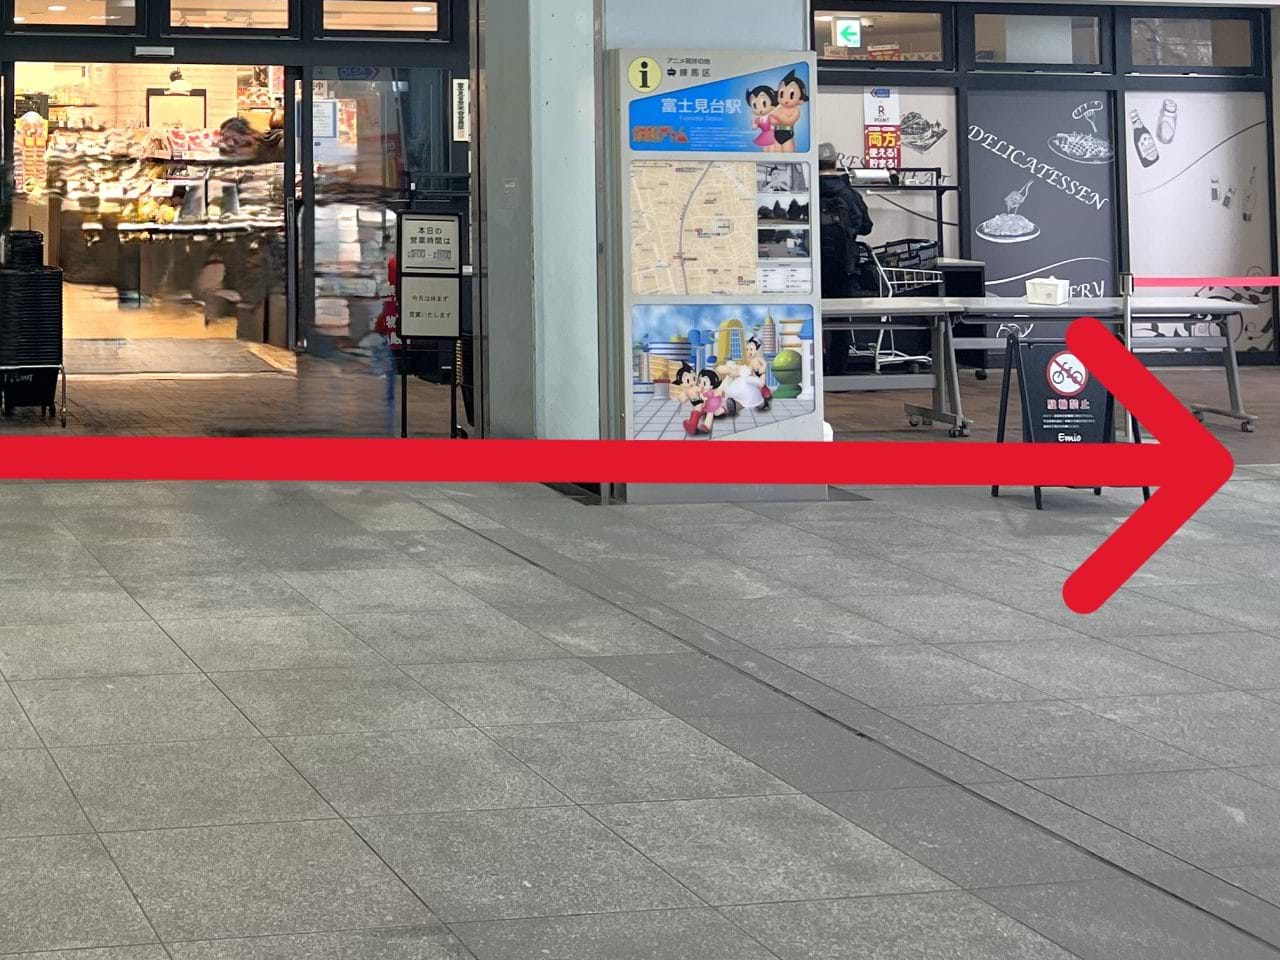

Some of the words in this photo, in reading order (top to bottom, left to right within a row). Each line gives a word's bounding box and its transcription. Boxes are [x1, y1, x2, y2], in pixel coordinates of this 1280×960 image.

[661, 98, 742, 114] 富士見台駅
[878, 105, 885, 115] R
[868, 131, 897, 147] 両方
[968, 125, 1109, 210] DELICATESSEN
[418, 226, 442, 235] 本日の
[410, 236, 451, 245] 営業時間は
[409, 311, 451, 319] 営業いたします
[1058, 432, 1082, 442] Emio
